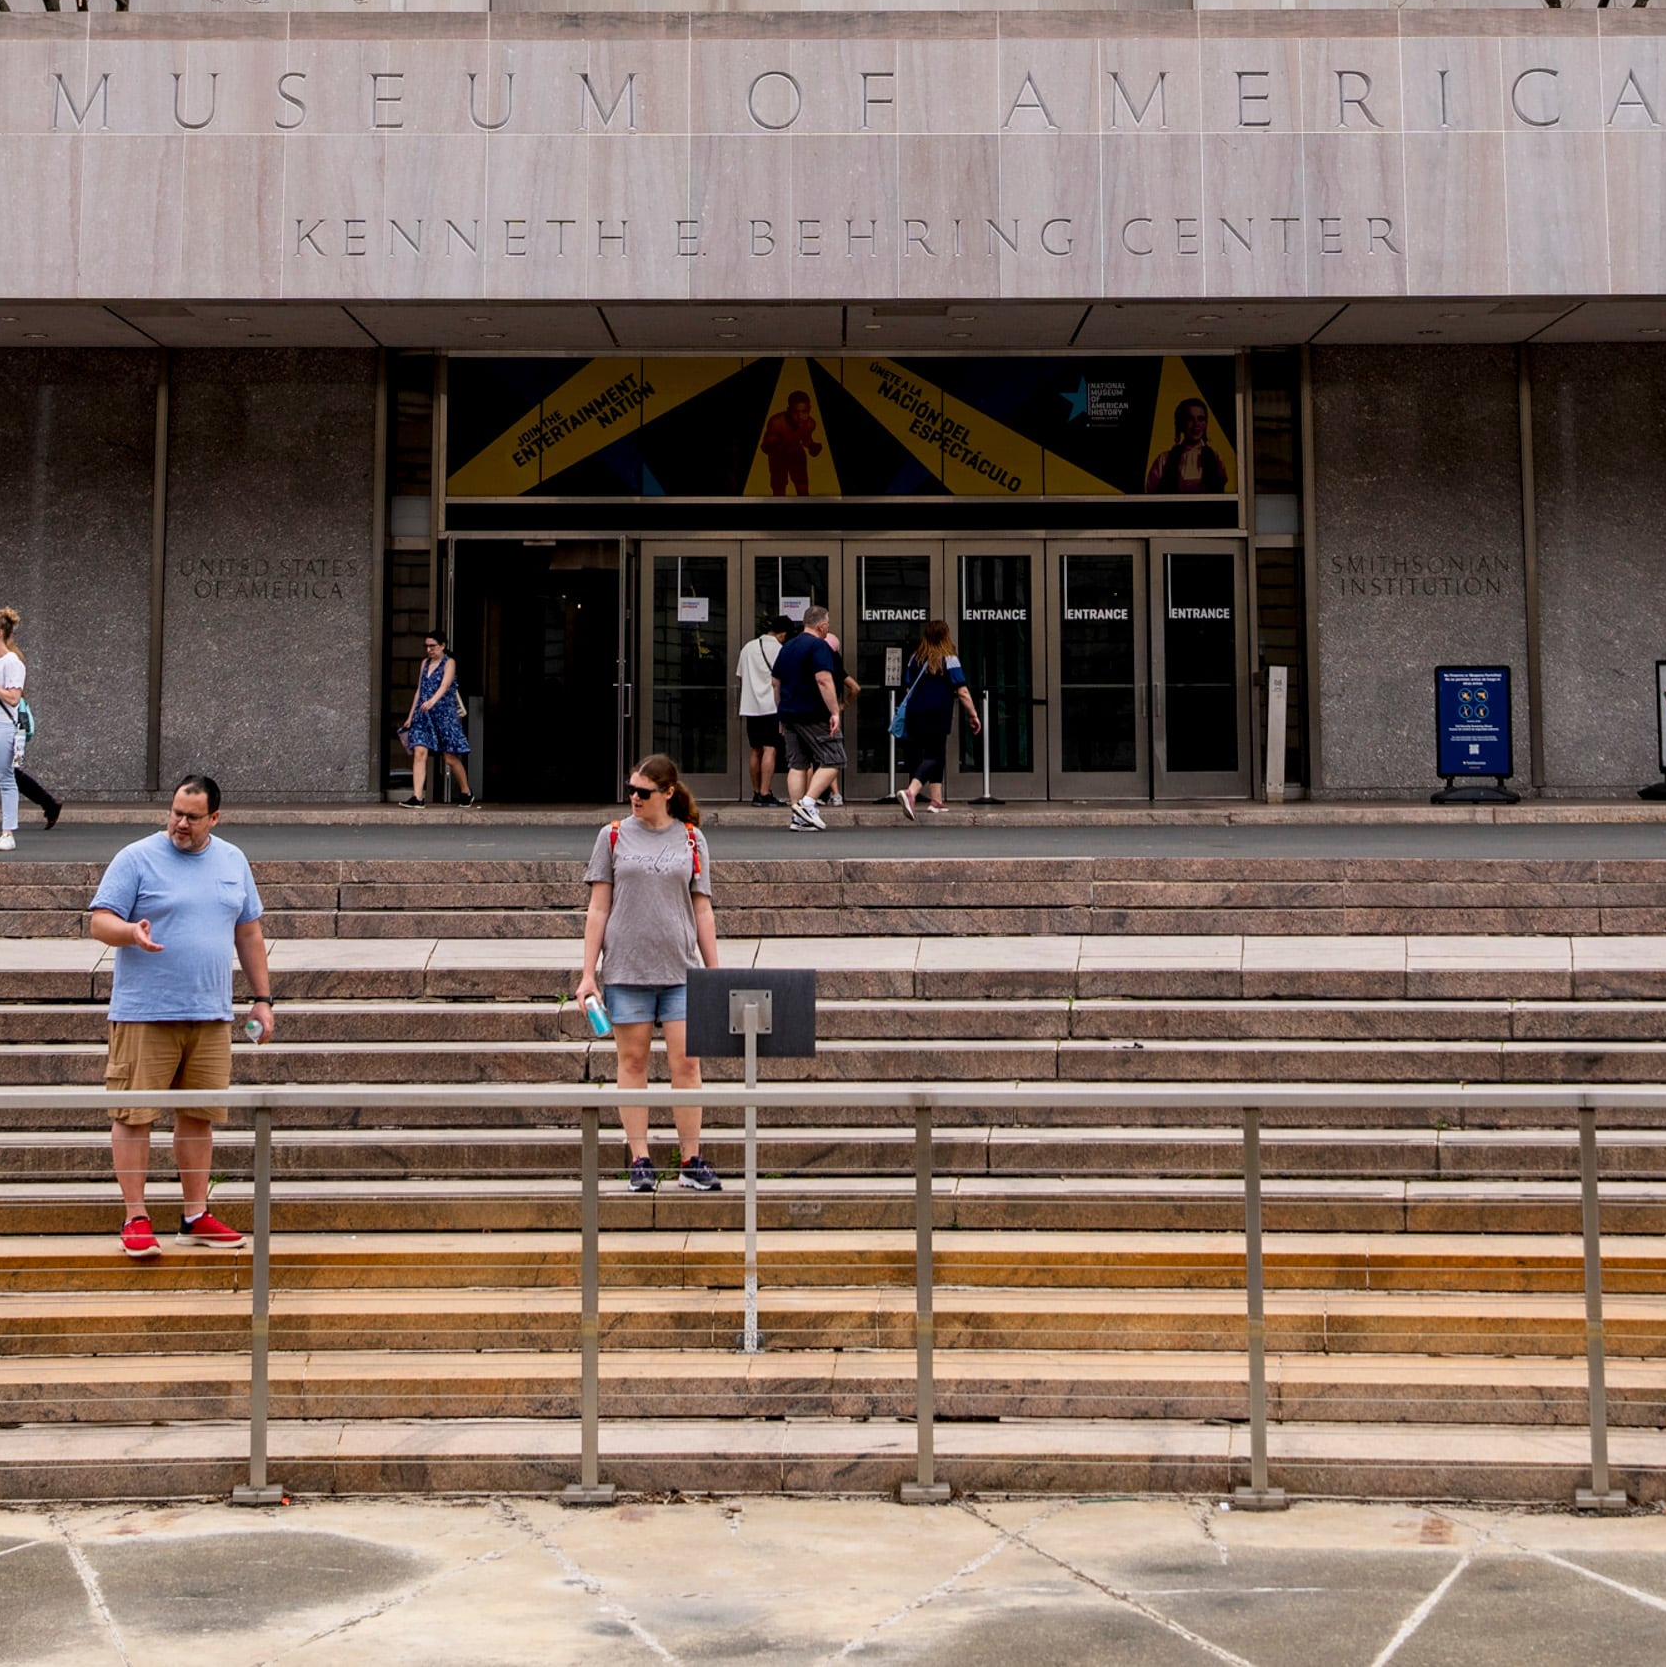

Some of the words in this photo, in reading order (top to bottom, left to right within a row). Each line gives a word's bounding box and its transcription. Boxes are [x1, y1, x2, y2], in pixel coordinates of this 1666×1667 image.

[50, 72, 635, 131] MUSEUM
[748, 72, 894, 131] OF
[293, 219, 628, 258] KENNETH
[749, 218, 1074, 257] BEHRING
[1122, 218, 1401, 256] CENTER
[900, 380, 909, 391] A
[909, 384, 923, 398] LA
[596, 381, 656, 429] NATION
[877, 380, 942, 426] NACIÓN
[940, 418, 970, 446] DEL
[512, 372, 638, 468] ENTERTAINMENT
[517, 423, 543, 448] JOIN
[542, 409, 563, 430] THE
[909, 418, 1022, 493] ESPECTÁCULO
[180, 558, 269, 577] UNITED
[279, 558, 358, 577] STATES
[1332, 555, 1510, 574] SMITHSONIAN
[195, 580, 226, 599] OF
[234, 580, 343, 599] AMERICA
[1341, 577, 1501, 596] INSTITUTION
[865, 609, 926, 620] ENTRANCE
[966, 609, 1027, 620] ENTRANCE
[1067, 608, 1128, 619] ENTRANCE
[1171, 608, 1230, 619] ENTRANCE
